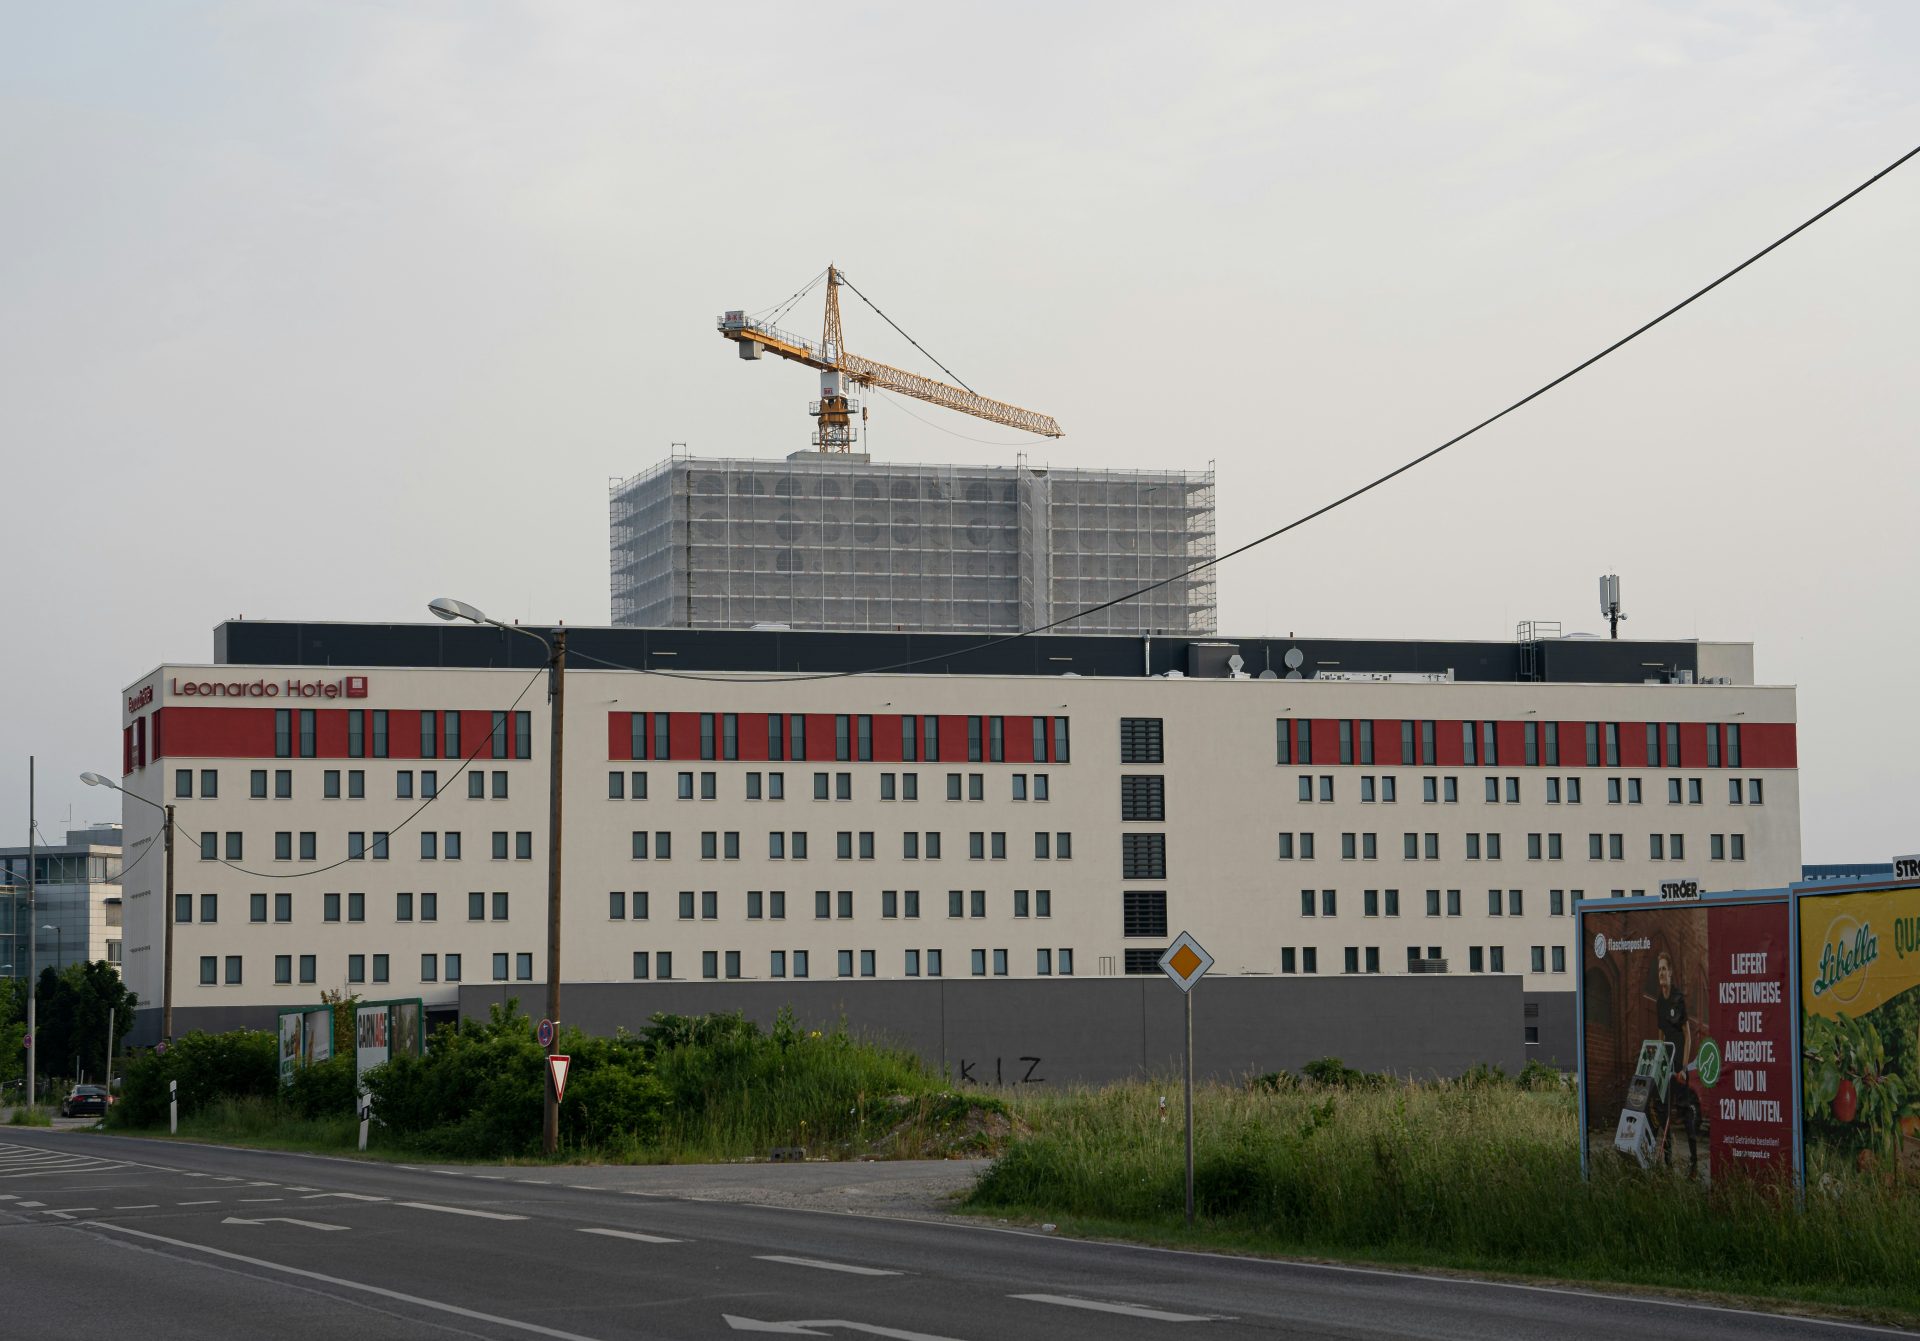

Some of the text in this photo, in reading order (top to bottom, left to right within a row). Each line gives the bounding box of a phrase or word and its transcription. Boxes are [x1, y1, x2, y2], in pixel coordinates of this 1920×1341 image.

[173, 678, 343, 698] Leonardo Hotel
[1608, 936, 1651, 952] flaschenpost.de
[1731, 953, 1767, 974] LIEFERT
[1813, 923, 1877, 996] Libella
[1719, 982, 1781, 1003] KISTENWEISE
[1738, 1011, 1762, 1033] GUTE
[1724, 1040, 1775, 1063] ANGEBOTE.
[1734, 1070, 1766, 1092] UND IN
[1719, 1098, 1783, 1122] 120 MINUTEN.
